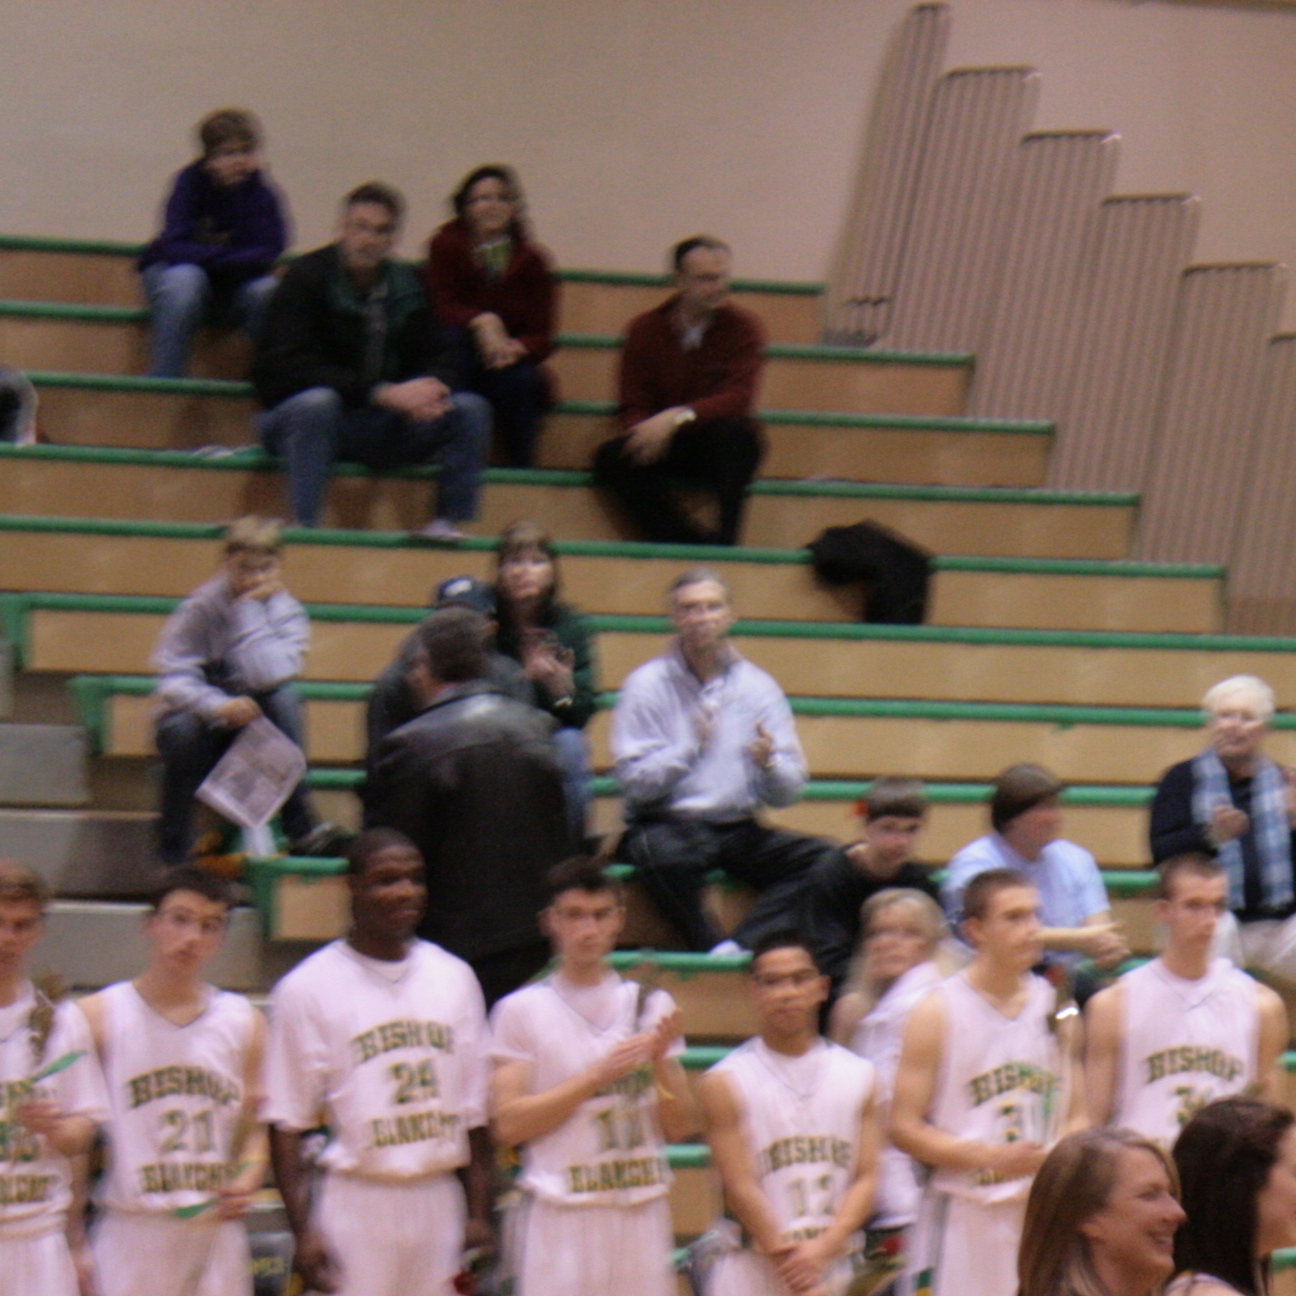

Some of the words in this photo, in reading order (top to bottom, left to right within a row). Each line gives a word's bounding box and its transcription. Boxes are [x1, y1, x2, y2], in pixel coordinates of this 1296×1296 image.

[125, 1064, 246, 1110] BISHOP
[1144, 1043, 1246, 1087] BISHOP
[158, 1107, 218, 1155] 21
